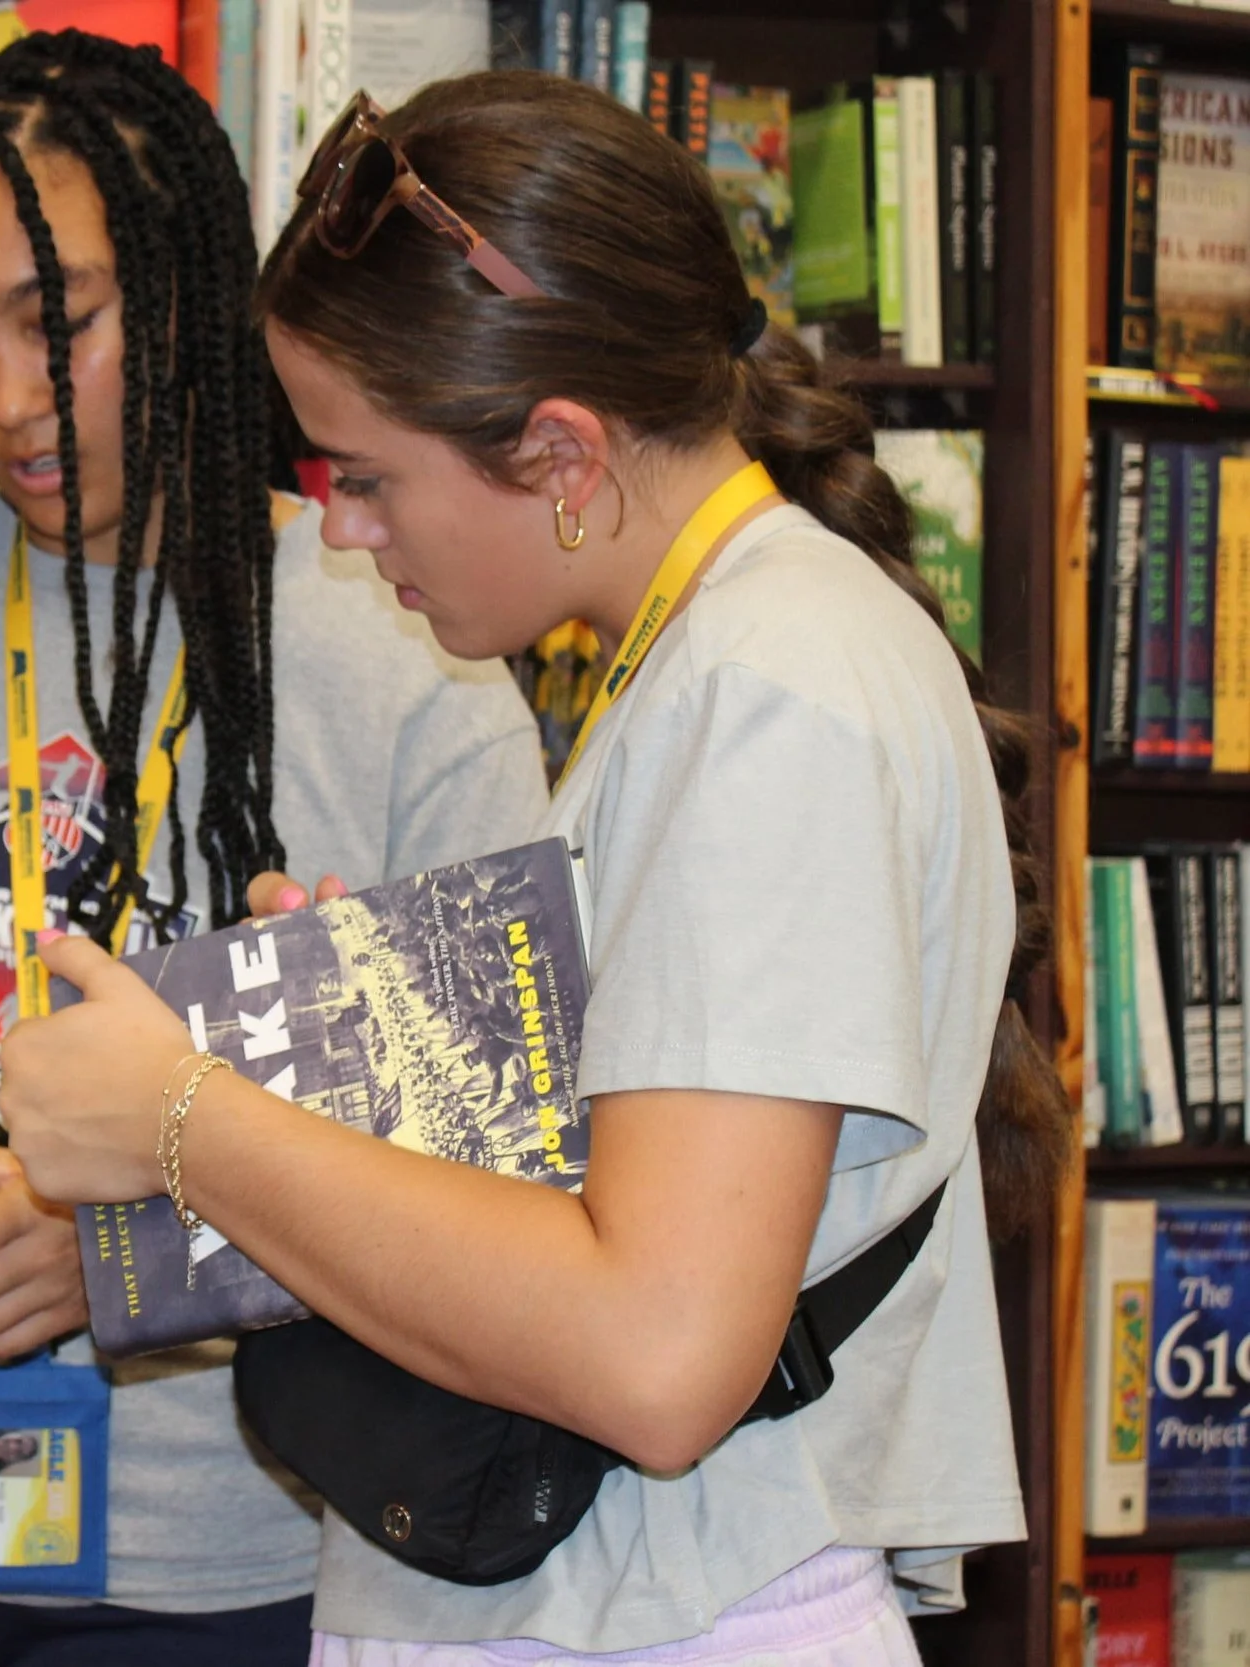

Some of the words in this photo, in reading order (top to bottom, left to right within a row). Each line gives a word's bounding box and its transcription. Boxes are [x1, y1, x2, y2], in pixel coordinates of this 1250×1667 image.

[650, 71, 669, 136] PEST
[688, 72, 708, 152] PESTS
[1161, 133, 1235, 170] SIONS
[507, 920, 552, 1096] GRINSPAN
[544, 955, 562, 1018] ACRIMONY
[537, 1105, 566, 1173] JON
[97, 1225, 112, 1262] THE
[114, 1204, 133, 1267] ELECTE
[124, 1272, 141, 1318] THAT
[1178, 1275, 1234, 1309] The
[1148, 1310, 1250, 1417] 61
[48, 1430, 66, 1483] AGLE
[1156, 1414, 1249, 1454] Project
